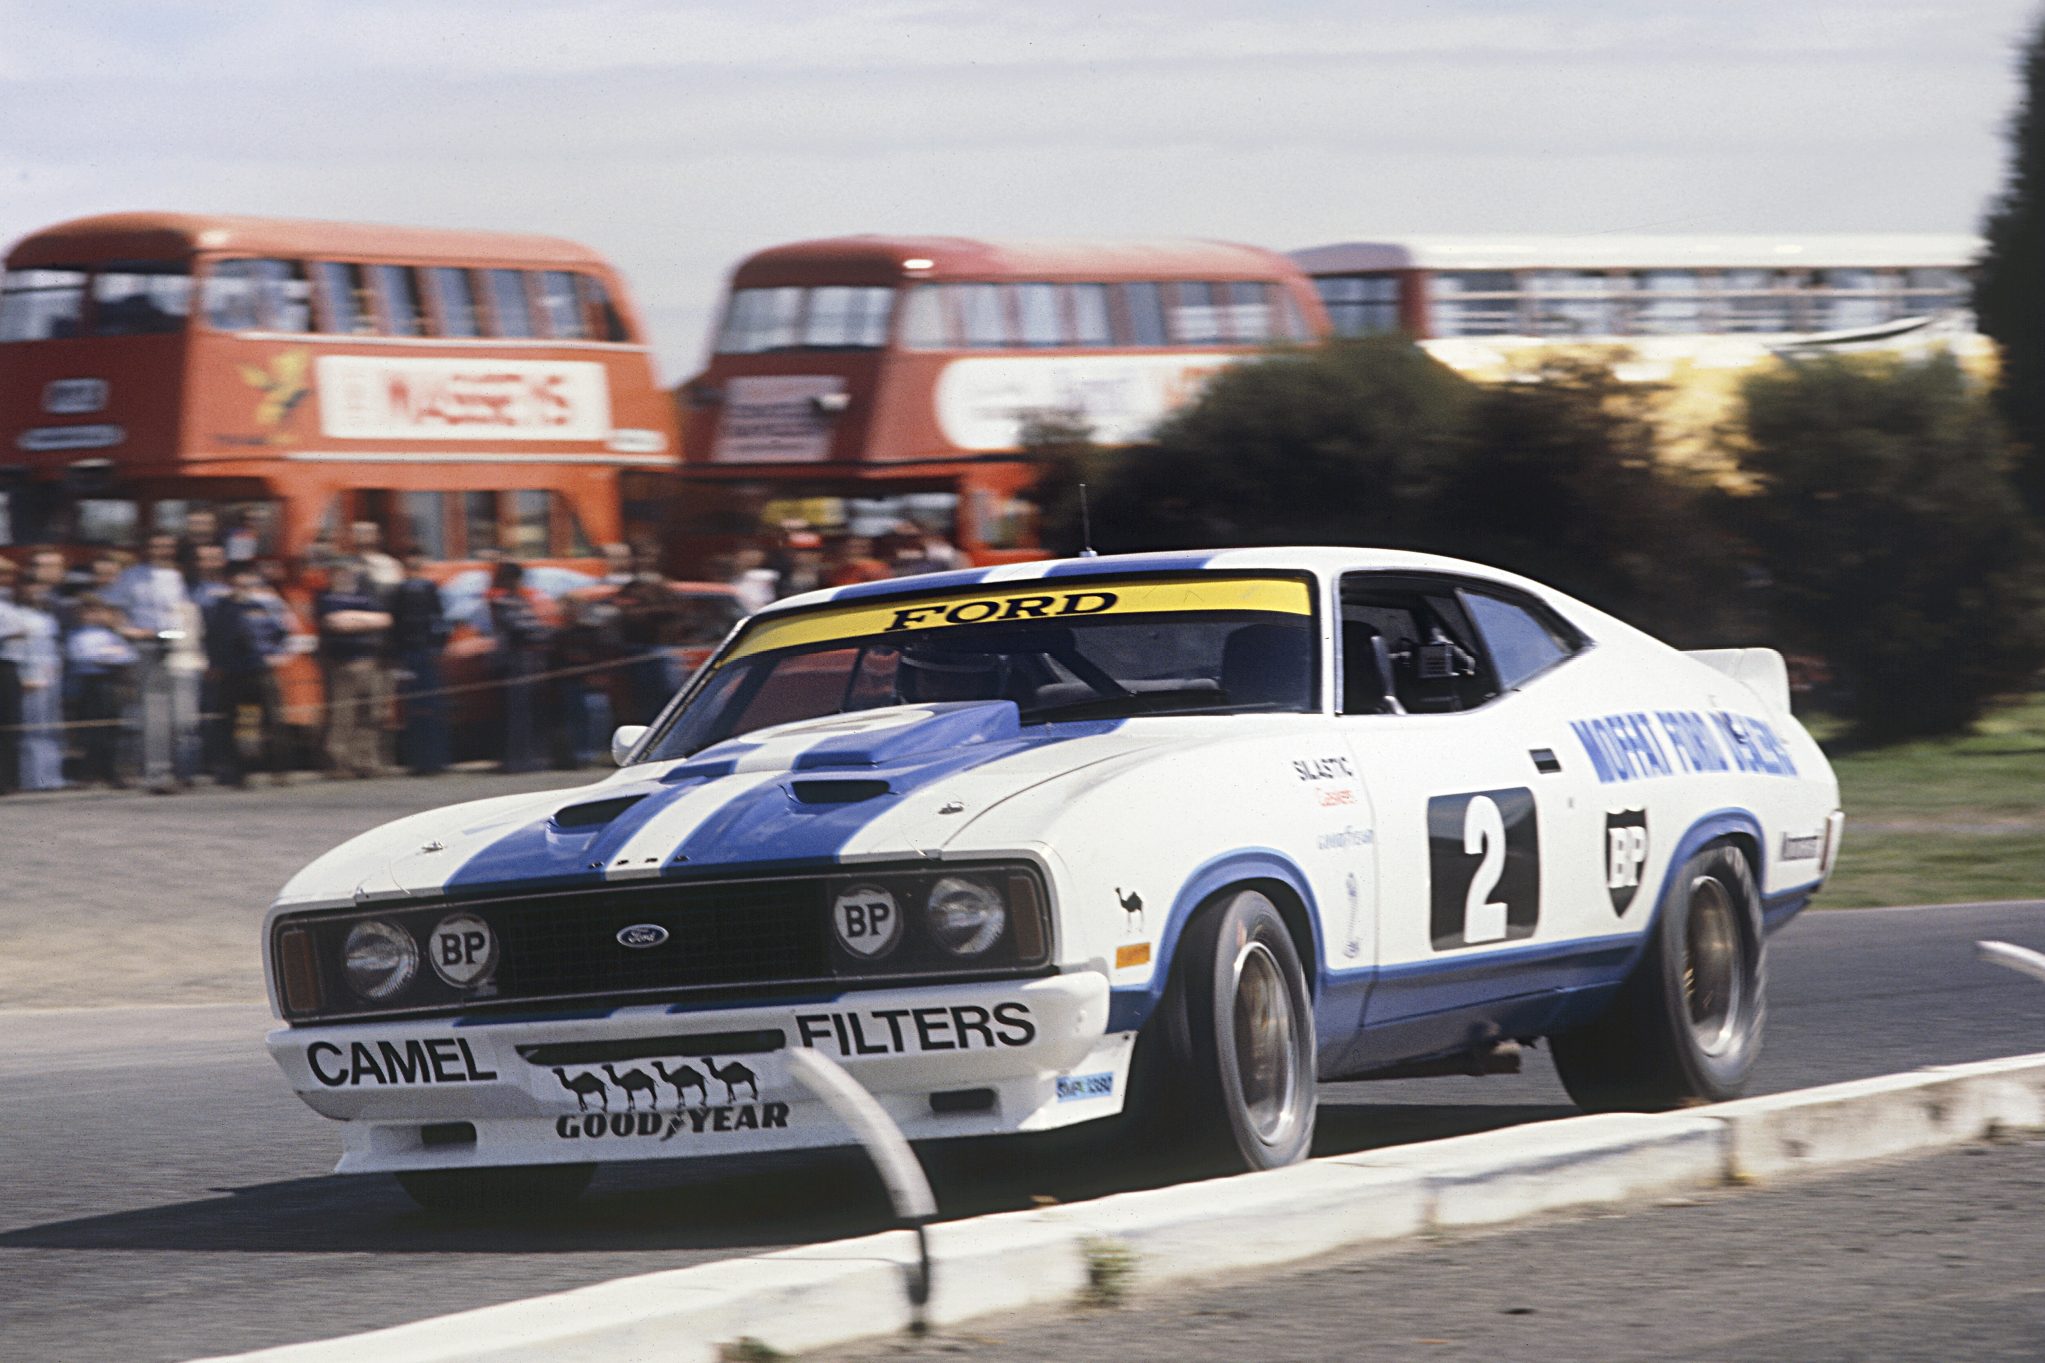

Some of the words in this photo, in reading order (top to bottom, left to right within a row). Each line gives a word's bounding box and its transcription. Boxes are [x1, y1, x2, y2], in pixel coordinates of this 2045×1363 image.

[884, 592, 1118, 631] FORD
[1463, 795, 1508, 943] 2
[1608, 826, 1647, 888] BP
[843, 900, 893, 938] BP
[440, 930, 486, 966] BP
[306, 1038, 498, 1087] CAMEL
[796, 1002, 1037, 1057] FILTERS
[555, 1102, 790, 1141] GOODYEAR
